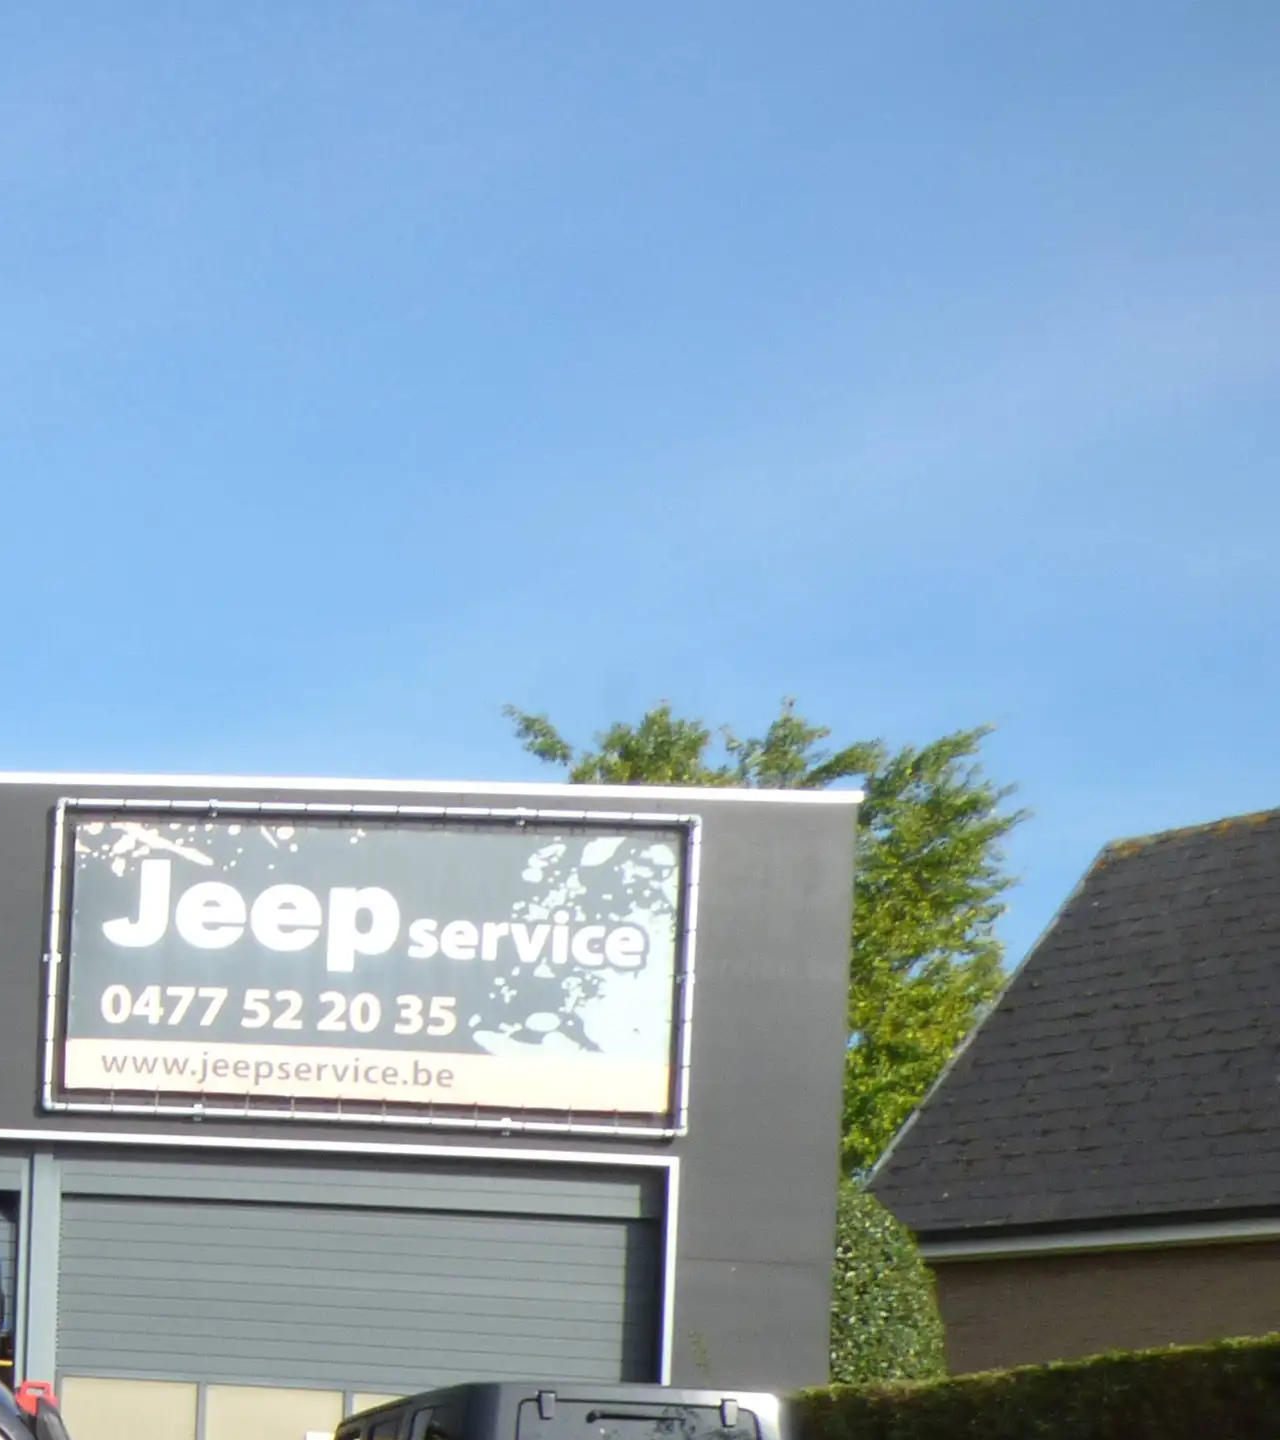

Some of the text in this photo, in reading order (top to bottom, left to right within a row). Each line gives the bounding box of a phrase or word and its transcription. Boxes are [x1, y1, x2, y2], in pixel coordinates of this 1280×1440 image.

[101, 858, 646, 974] Jeep service
[101, 984, 458, 1037] 0477 52 20 35
[101, 1051, 454, 1088] www.jeepservice.be
